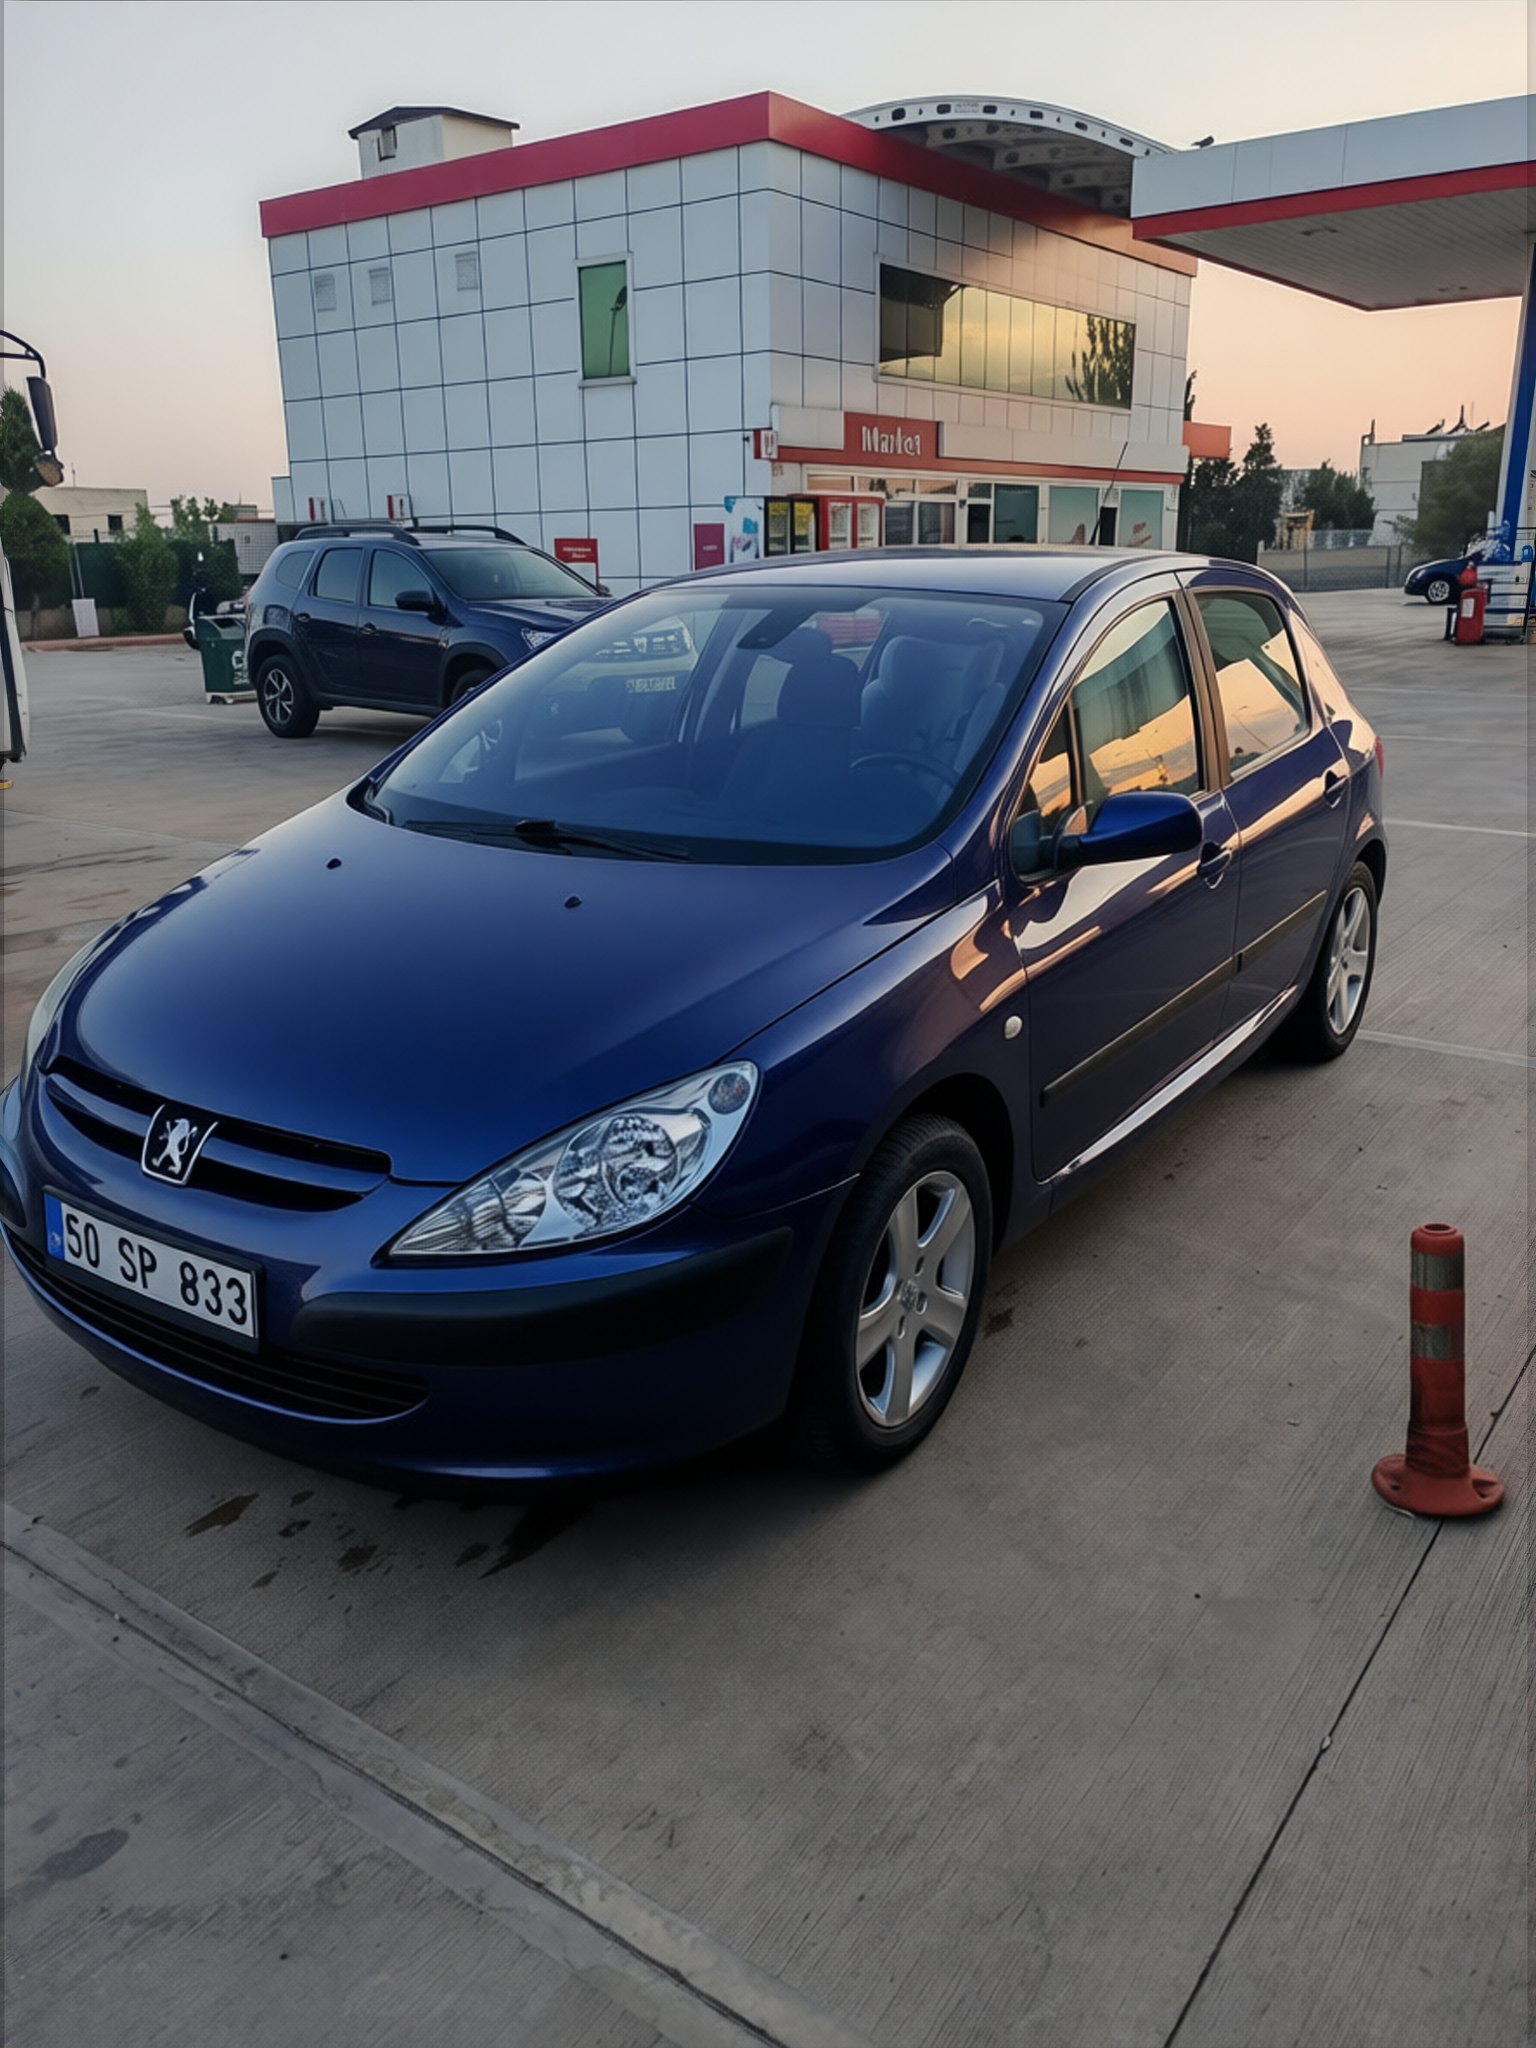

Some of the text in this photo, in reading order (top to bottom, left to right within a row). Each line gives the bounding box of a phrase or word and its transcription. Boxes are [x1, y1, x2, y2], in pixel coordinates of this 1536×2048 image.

[65, 1213, 247, 1326] 50 SP 833
